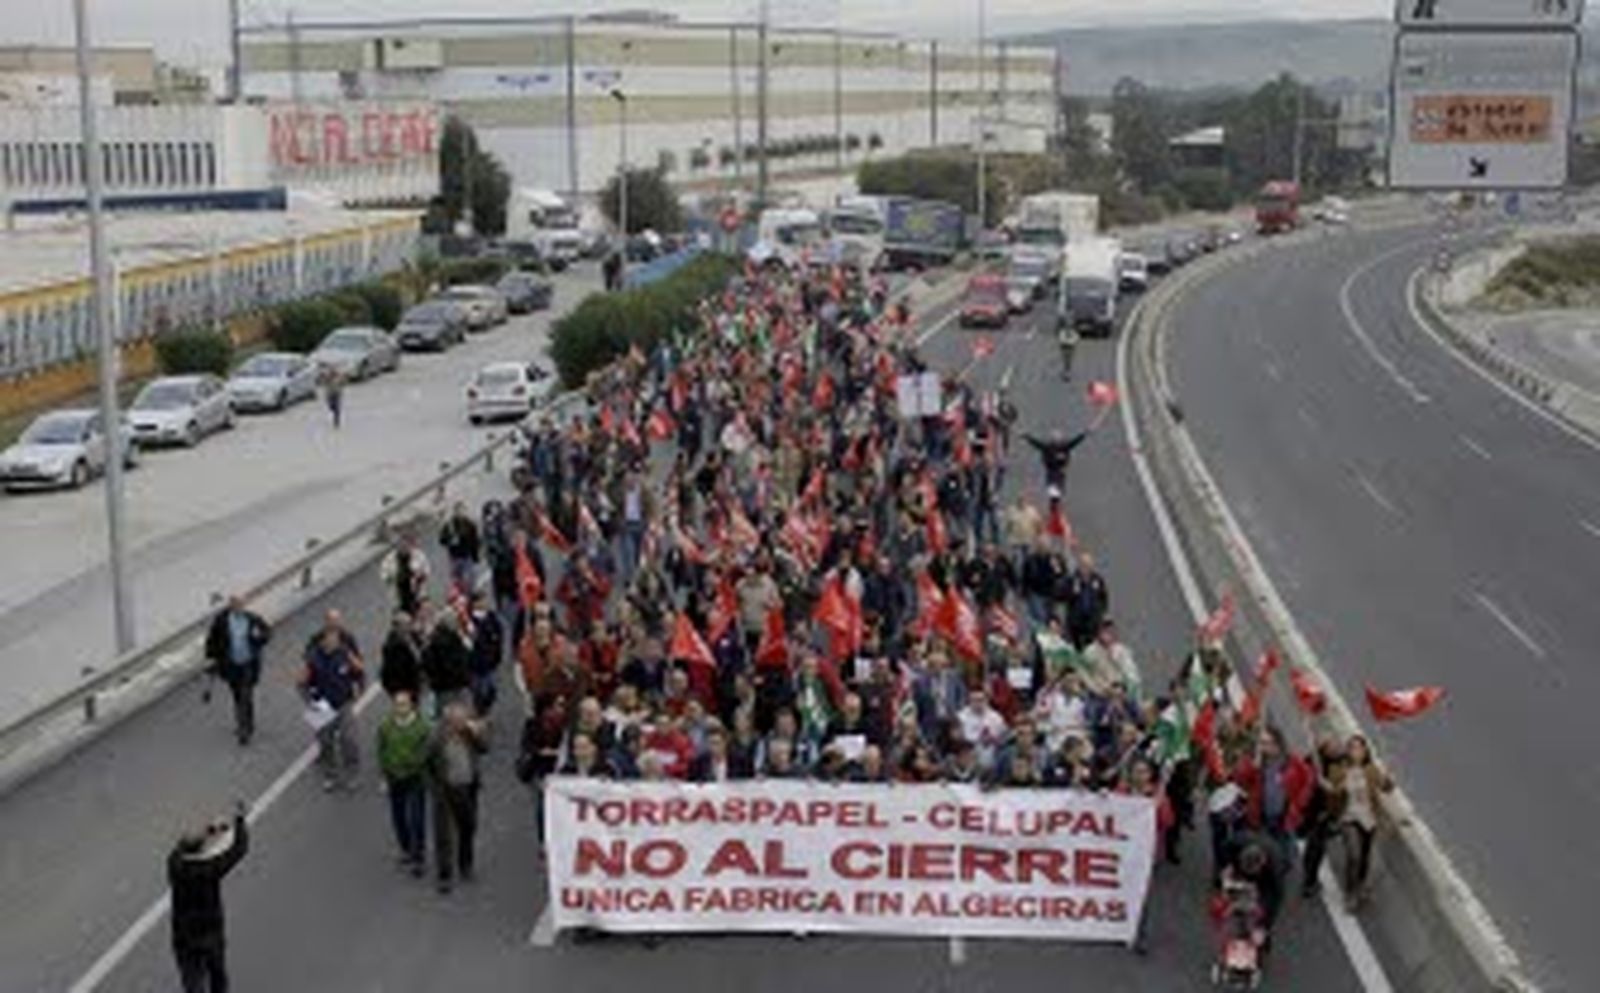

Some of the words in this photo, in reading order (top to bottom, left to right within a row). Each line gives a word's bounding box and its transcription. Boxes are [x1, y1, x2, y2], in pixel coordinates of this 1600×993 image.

[571, 796, 888, 828] TORRASPAPEL
[927, 802, 1129, 841] CELUPAL
[573, 837, 688, 879] NO
[702, 839, 808, 879] AL
[830, 841, 1121, 889] CIERRE
[560, 886, 675, 912] UNICA
[682, 887, 844, 914] FABRICA
[854, 891, 903, 916] EN
[911, 893, 1128, 922] ALGECIRAS
